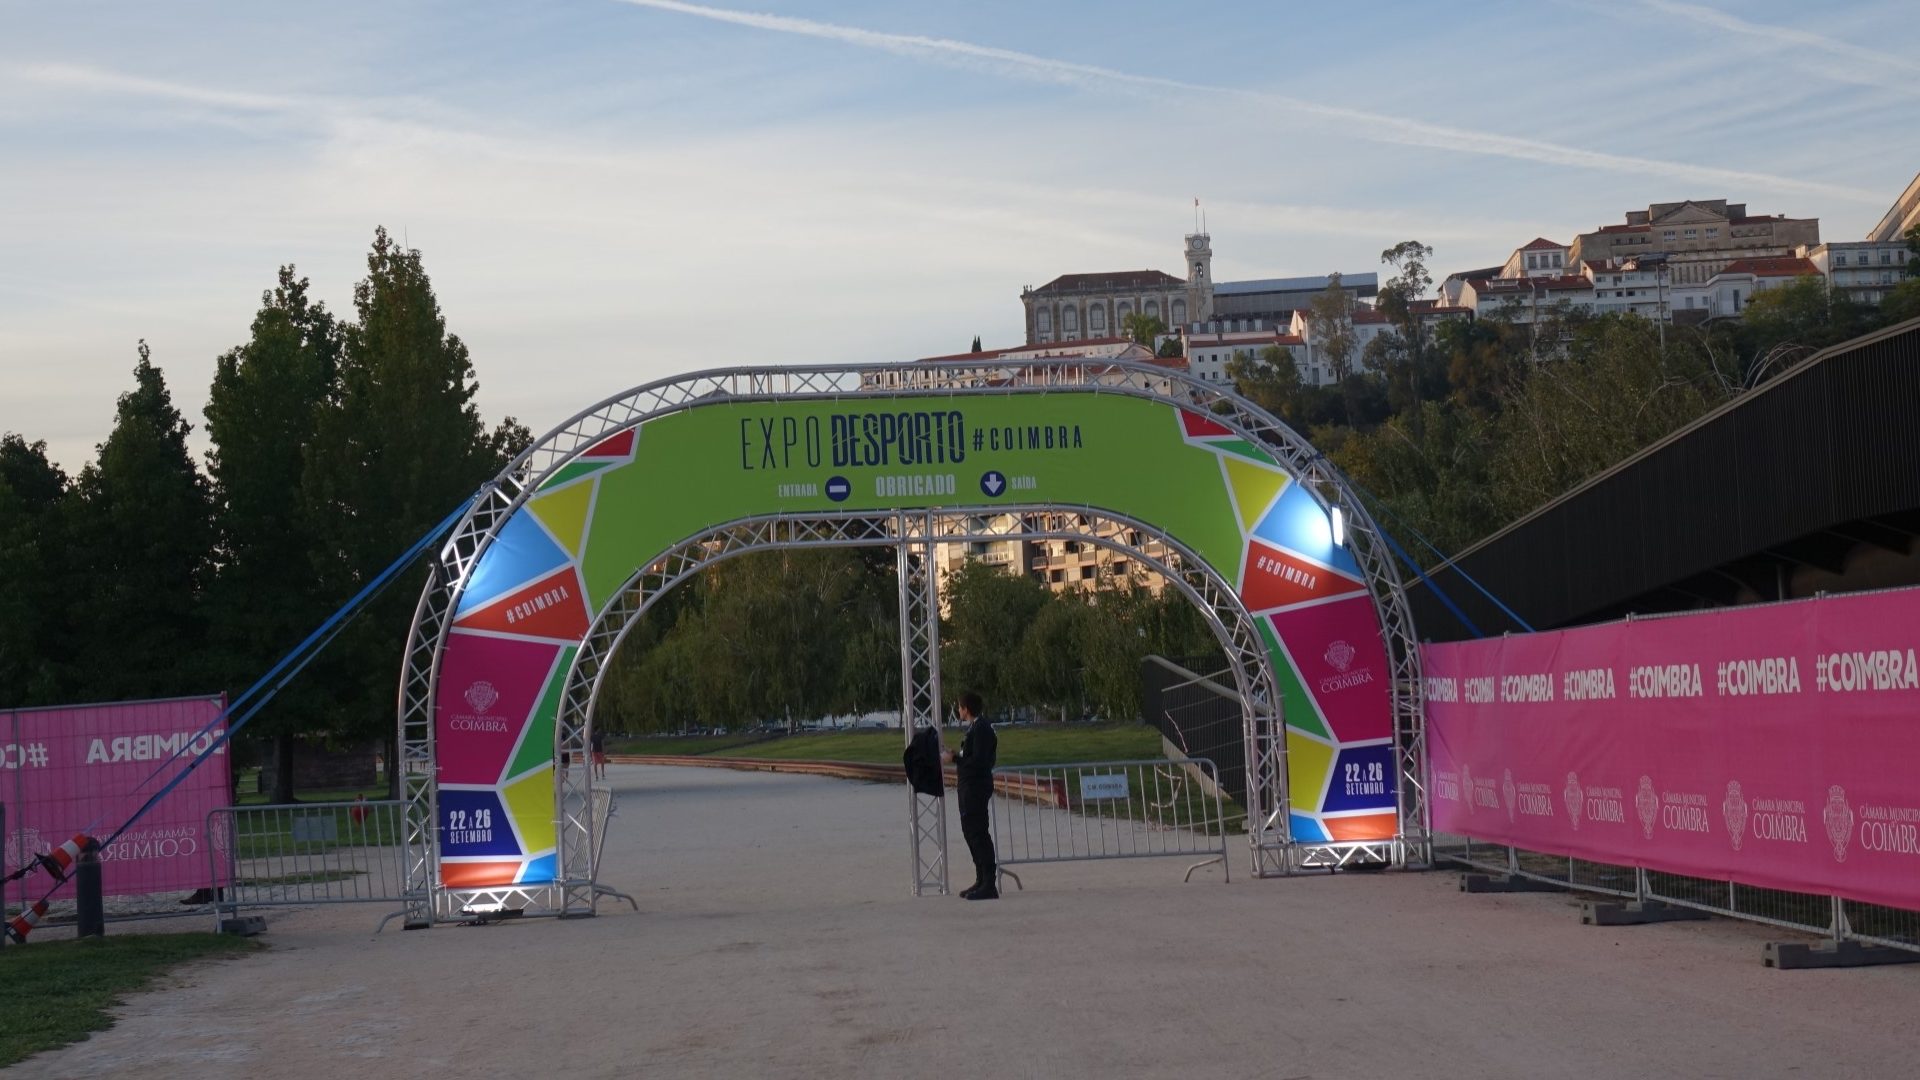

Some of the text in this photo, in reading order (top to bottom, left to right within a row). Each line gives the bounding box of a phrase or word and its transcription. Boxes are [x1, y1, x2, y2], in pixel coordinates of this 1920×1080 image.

[741, 410, 1083, 470] EXPO DESPORTO #COIMBRA
[778, 484, 818, 497] ENTRADA
[875, 474, 956, 498] OBRIGADO
[1257, 555, 1316, 590] #COIMBRA
[506, 585, 569, 624] #COIMBRA
[1321, 672, 1374, 693] COIMBRA
[1501, 673, 1554, 702] #COIMBRA
[1564, 668, 1616, 701] #COIMBRA
[1629, 664, 1703, 698] #COIMBRA
[1717, 656, 1801, 696] #COIMBRA
[1816, 649, 1919, 692] #COIMBRA
[450, 719, 508, 732] COIMBRA
[1345, 763, 1360, 782] 22
[1368, 762, 1383, 781] 26
[1346, 782, 1384, 795] SETEMBRO
[450, 809, 491, 830] 22 A 26
[1587, 798, 1625, 823] COIMBRA
[1663, 805, 1709, 833] COIMBRA
[1889, 805, 1920, 823] MUNICIP
[450, 829, 492, 844] SETEMBRO
[1753, 812, 1807, 843] COIMBRA
[1860, 821, 1920, 854] COIMBR
